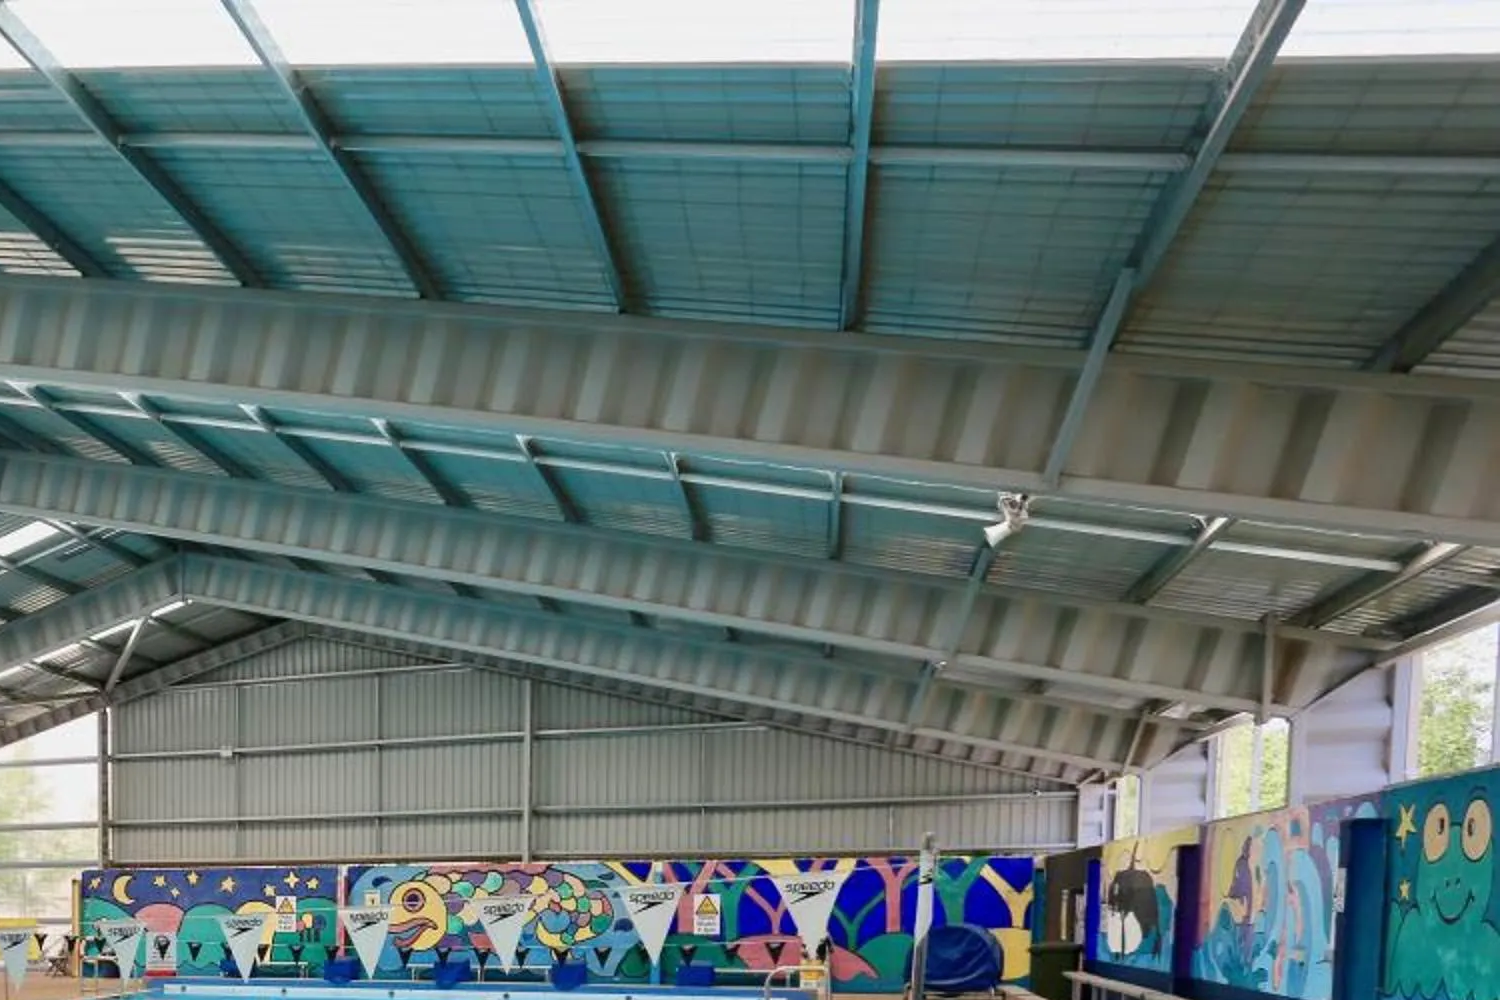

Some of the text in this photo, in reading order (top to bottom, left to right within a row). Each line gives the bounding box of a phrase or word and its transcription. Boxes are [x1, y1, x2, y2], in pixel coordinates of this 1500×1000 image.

[785, 880, 835, 894] speedo
[629, 891, 675, 904] speedo
[483, 902, 525, 914] speedo
[350, 910, 390, 922] speedo
[225, 917, 262, 928] speedo
